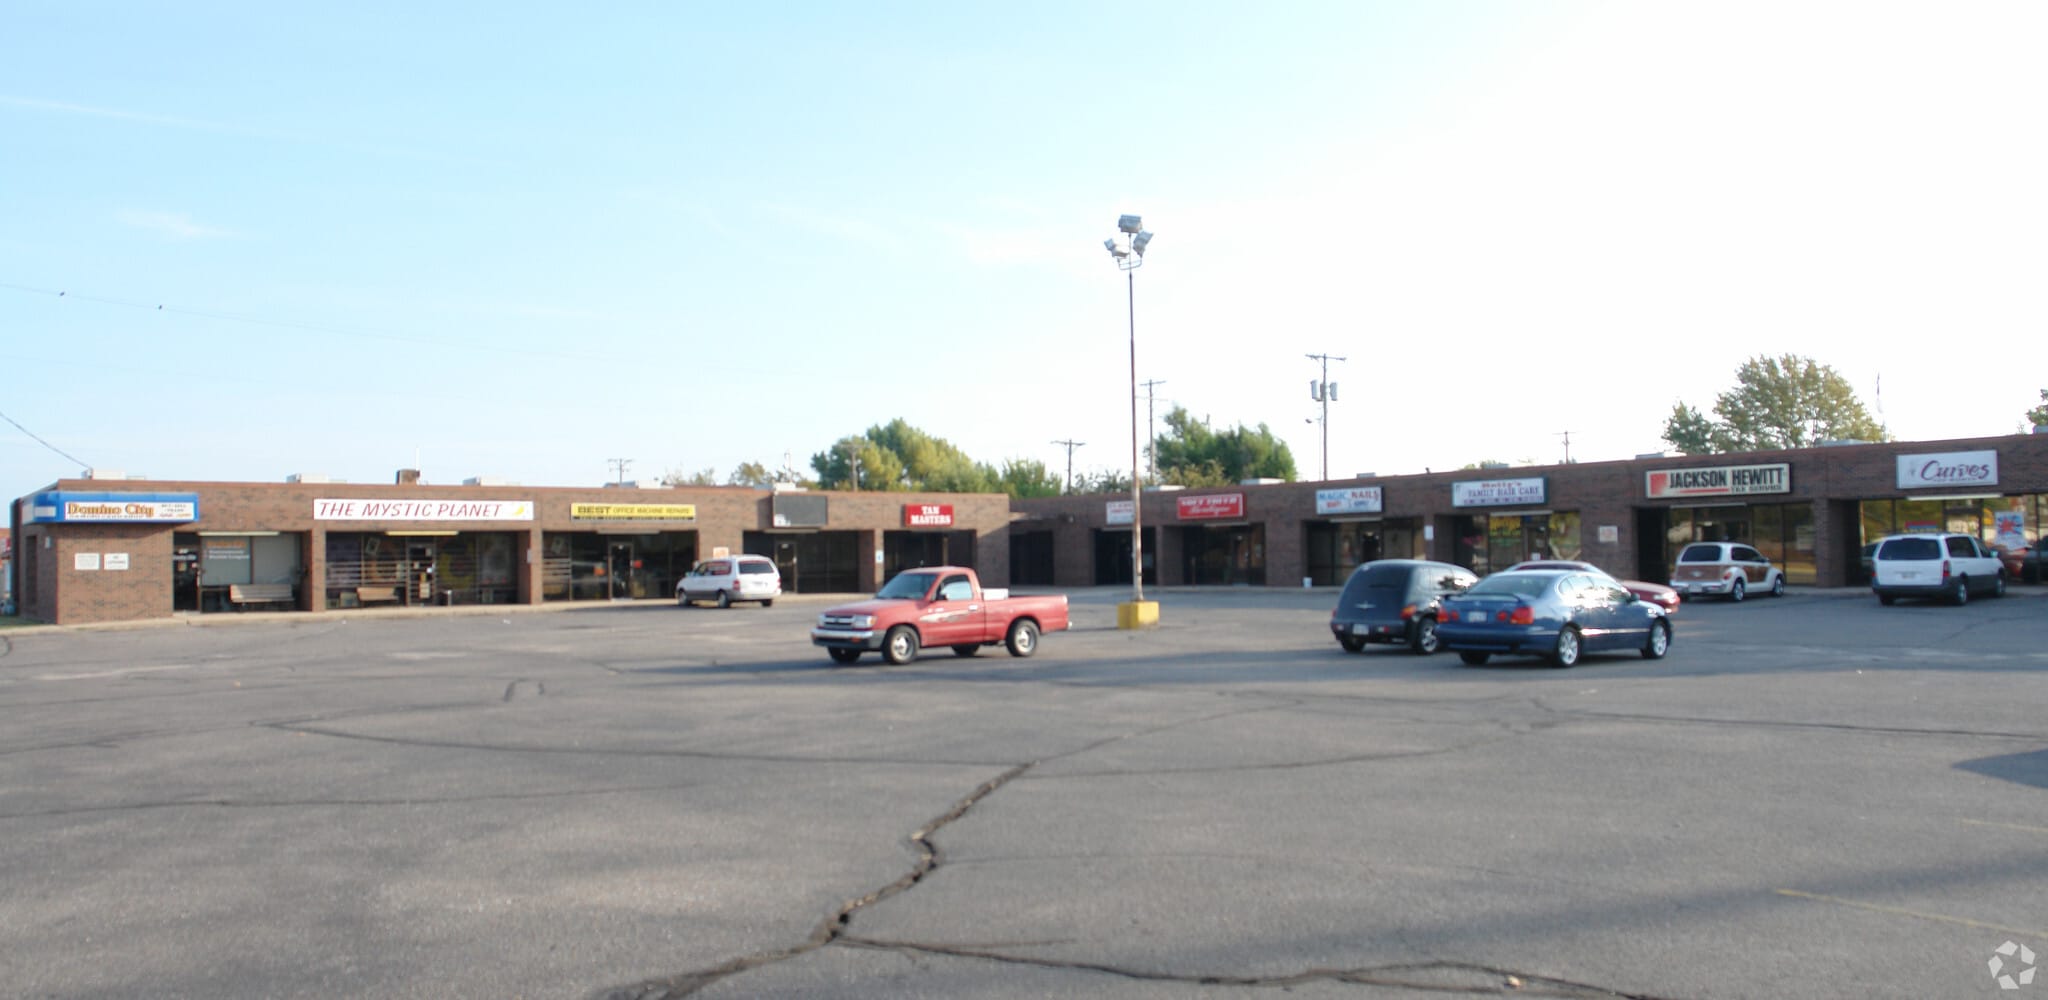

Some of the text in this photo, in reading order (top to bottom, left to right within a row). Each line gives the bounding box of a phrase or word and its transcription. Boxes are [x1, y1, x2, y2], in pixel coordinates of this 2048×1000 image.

[1670, 467, 1784, 488] JACKSON HEWITT
[1920, 460, 1990, 480] Curves
[68, 503, 154, 518] Domino City
[319, 502, 503, 518] THE MYSTIC PLANET
[577, 505, 611, 514] BEST
[911, 506, 951, 525] TAN MASTERS
